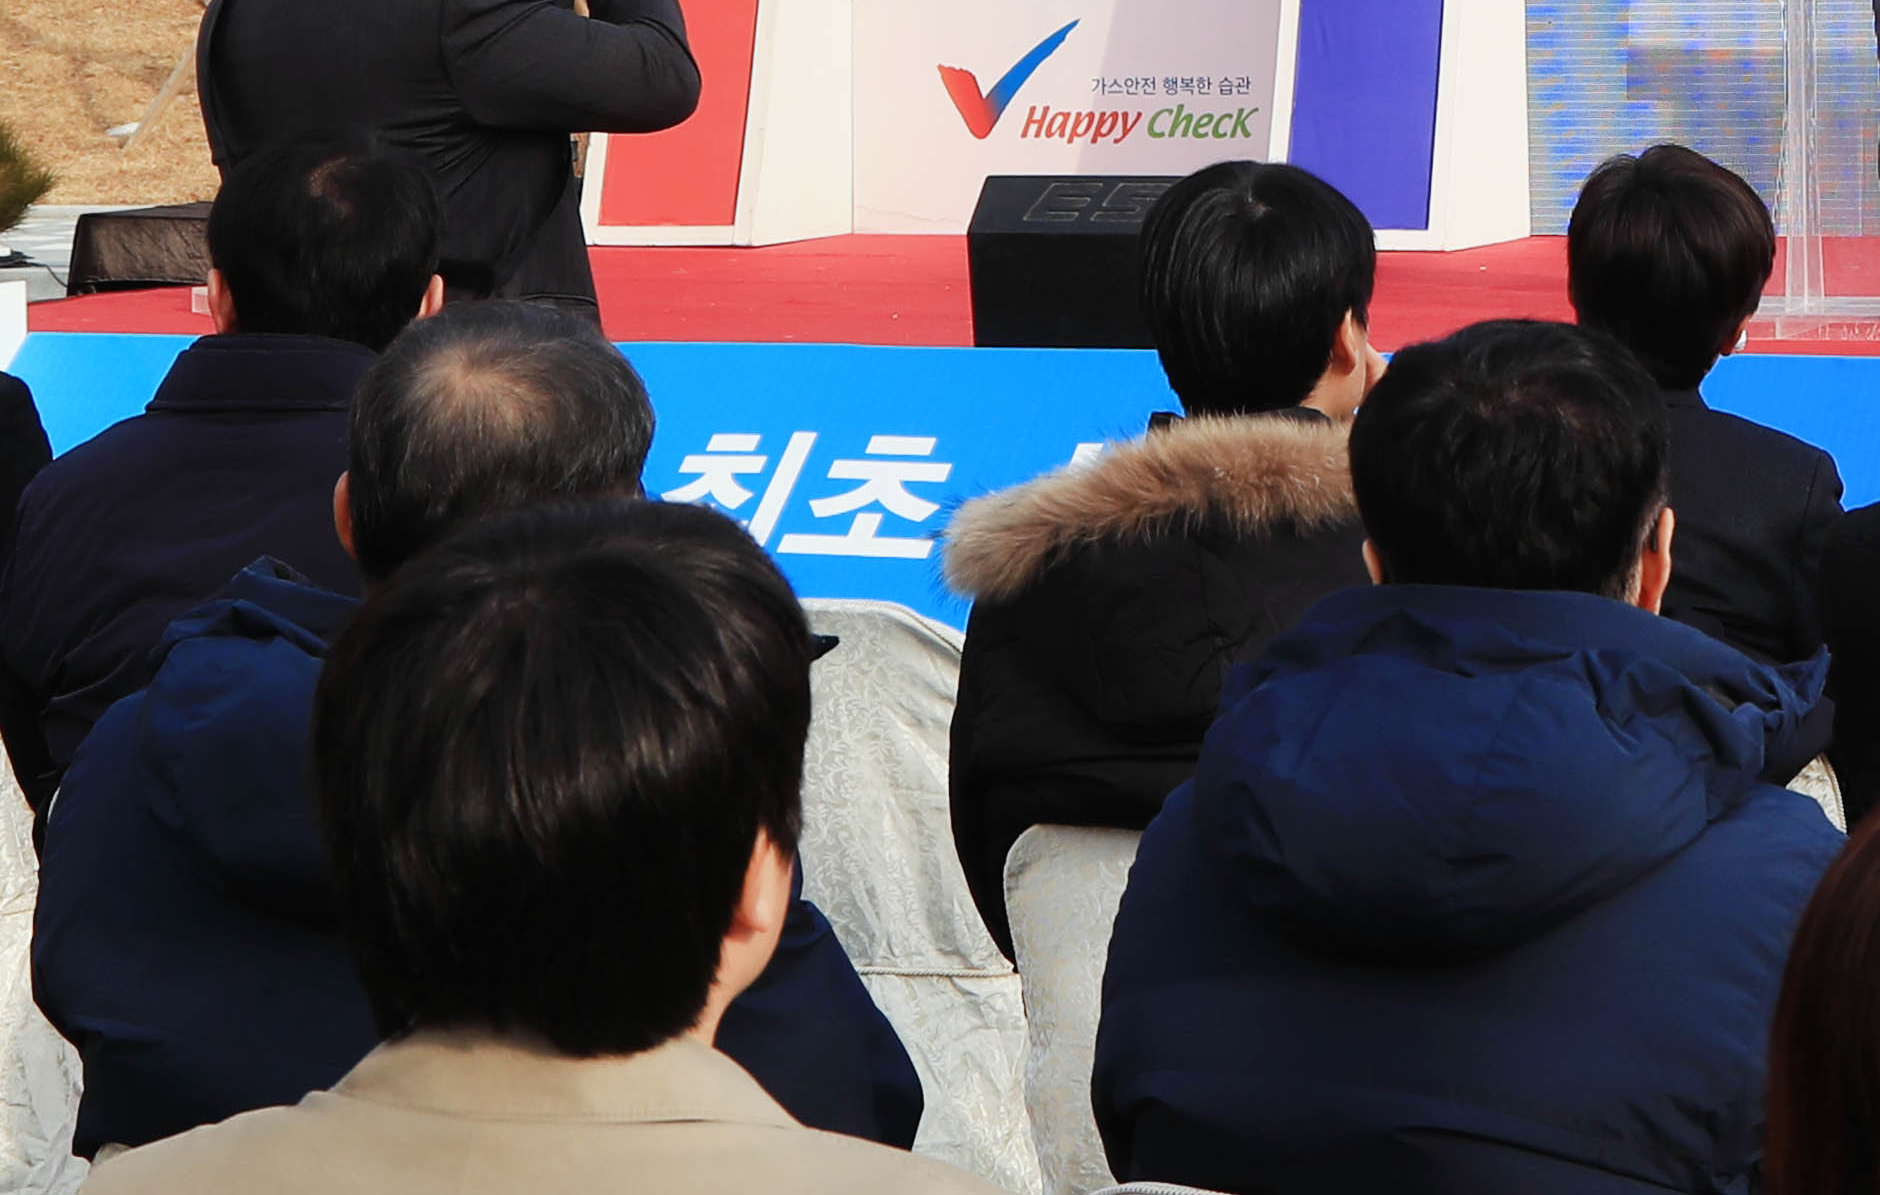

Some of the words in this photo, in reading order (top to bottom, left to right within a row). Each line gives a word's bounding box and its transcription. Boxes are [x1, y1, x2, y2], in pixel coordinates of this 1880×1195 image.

[1091, 77, 1157, 96] 가스안전
[1162, 76, 1212, 95] 행복한
[1218, 75, 1252, 95] 습관
[1020, 105, 1142, 144] Happy
[661, 430, 953, 559] 최초
